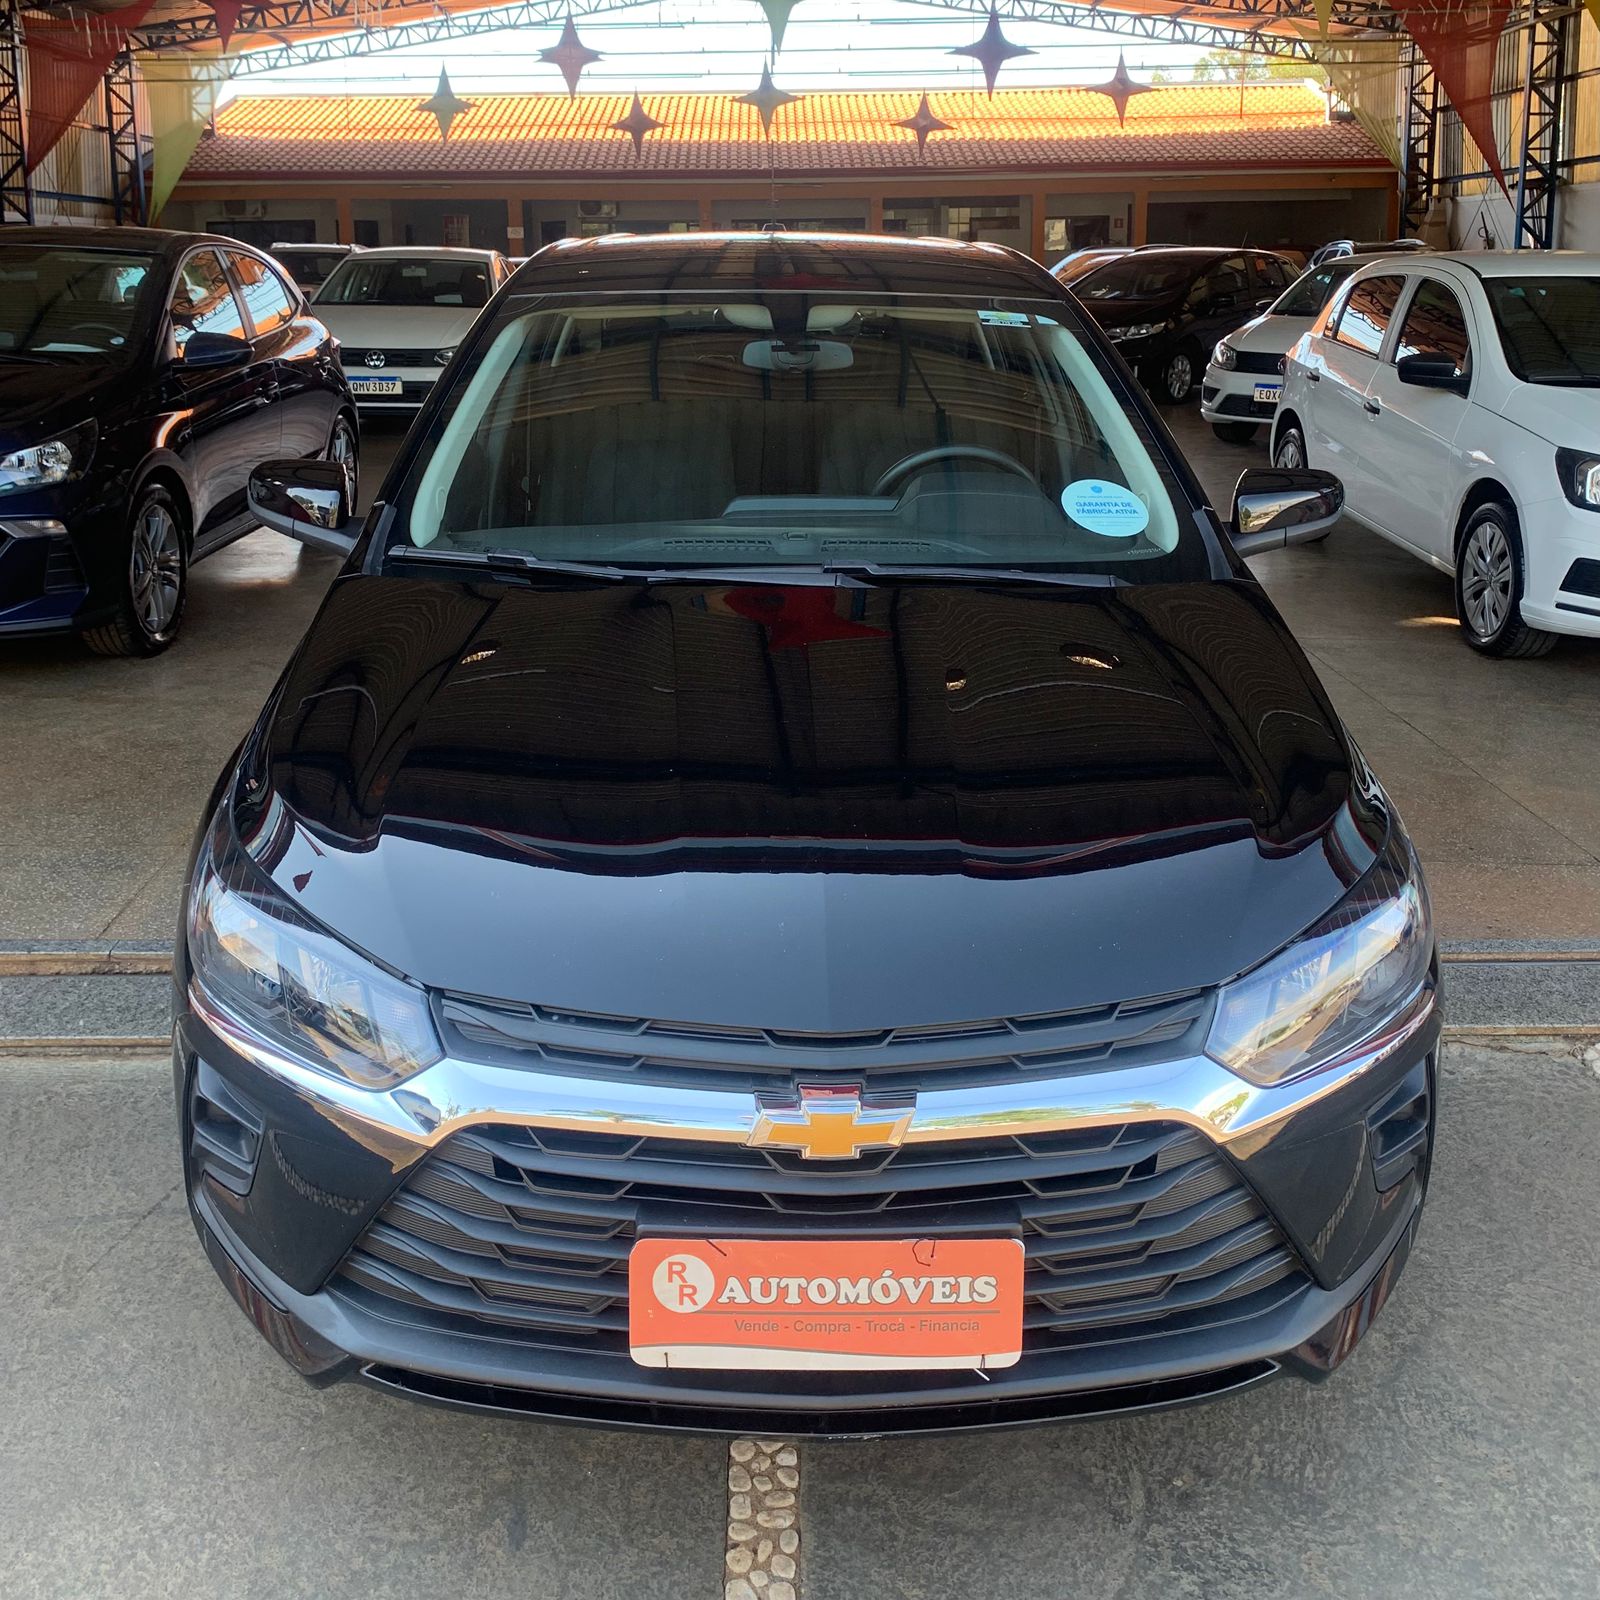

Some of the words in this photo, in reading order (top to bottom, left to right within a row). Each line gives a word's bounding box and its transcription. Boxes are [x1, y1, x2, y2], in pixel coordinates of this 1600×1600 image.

[352, 382, 396, 392] QMV3D37
[666, 1261, 688, 1284] R
[678, 1284, 699, 1306] R
[716, 1269, 999, 1305] AUTOMÓVEIS
[734, 1319, 779, 1332] Vende
[793, 1320, 851, 1335] Compra
[864, 1320, 905, 1332] Troca
[919, 1318, 980, 1332] Financia
